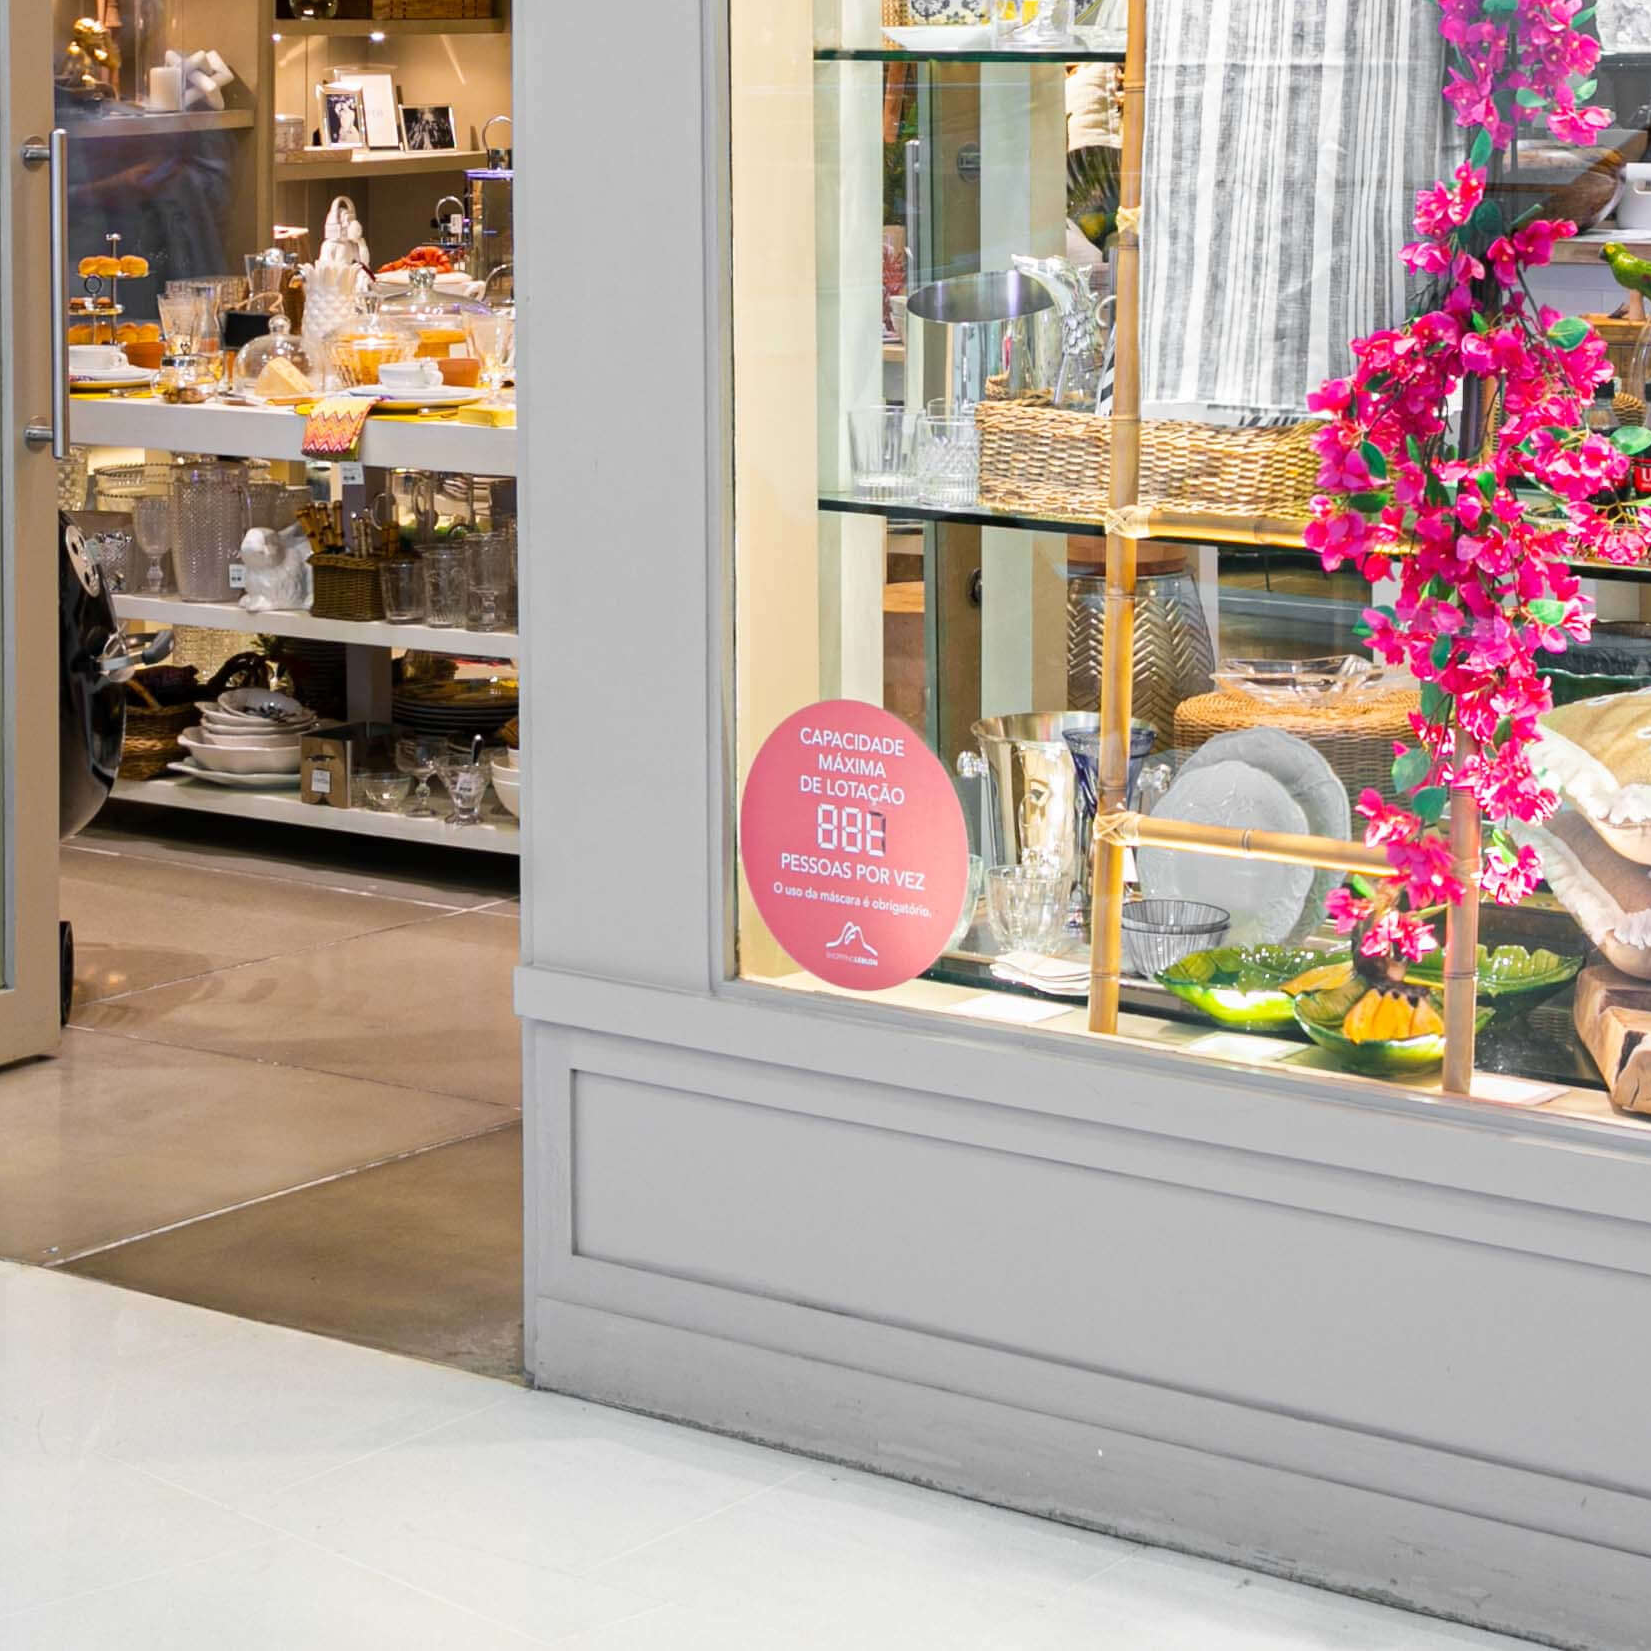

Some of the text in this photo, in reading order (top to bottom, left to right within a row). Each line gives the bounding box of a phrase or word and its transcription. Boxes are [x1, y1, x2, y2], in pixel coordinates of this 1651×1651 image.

[800, 727, 905, 757] CAPACIDADE
[818, 752, 887, 778] MÁXIMA
[800, 775, 905, 806] DE LOTAÇÃO
[781, 853, 926, 891] PESSOAS POR VEZ
[773, 881, 783, 894] O
[785, 886, 803, 897] uso
